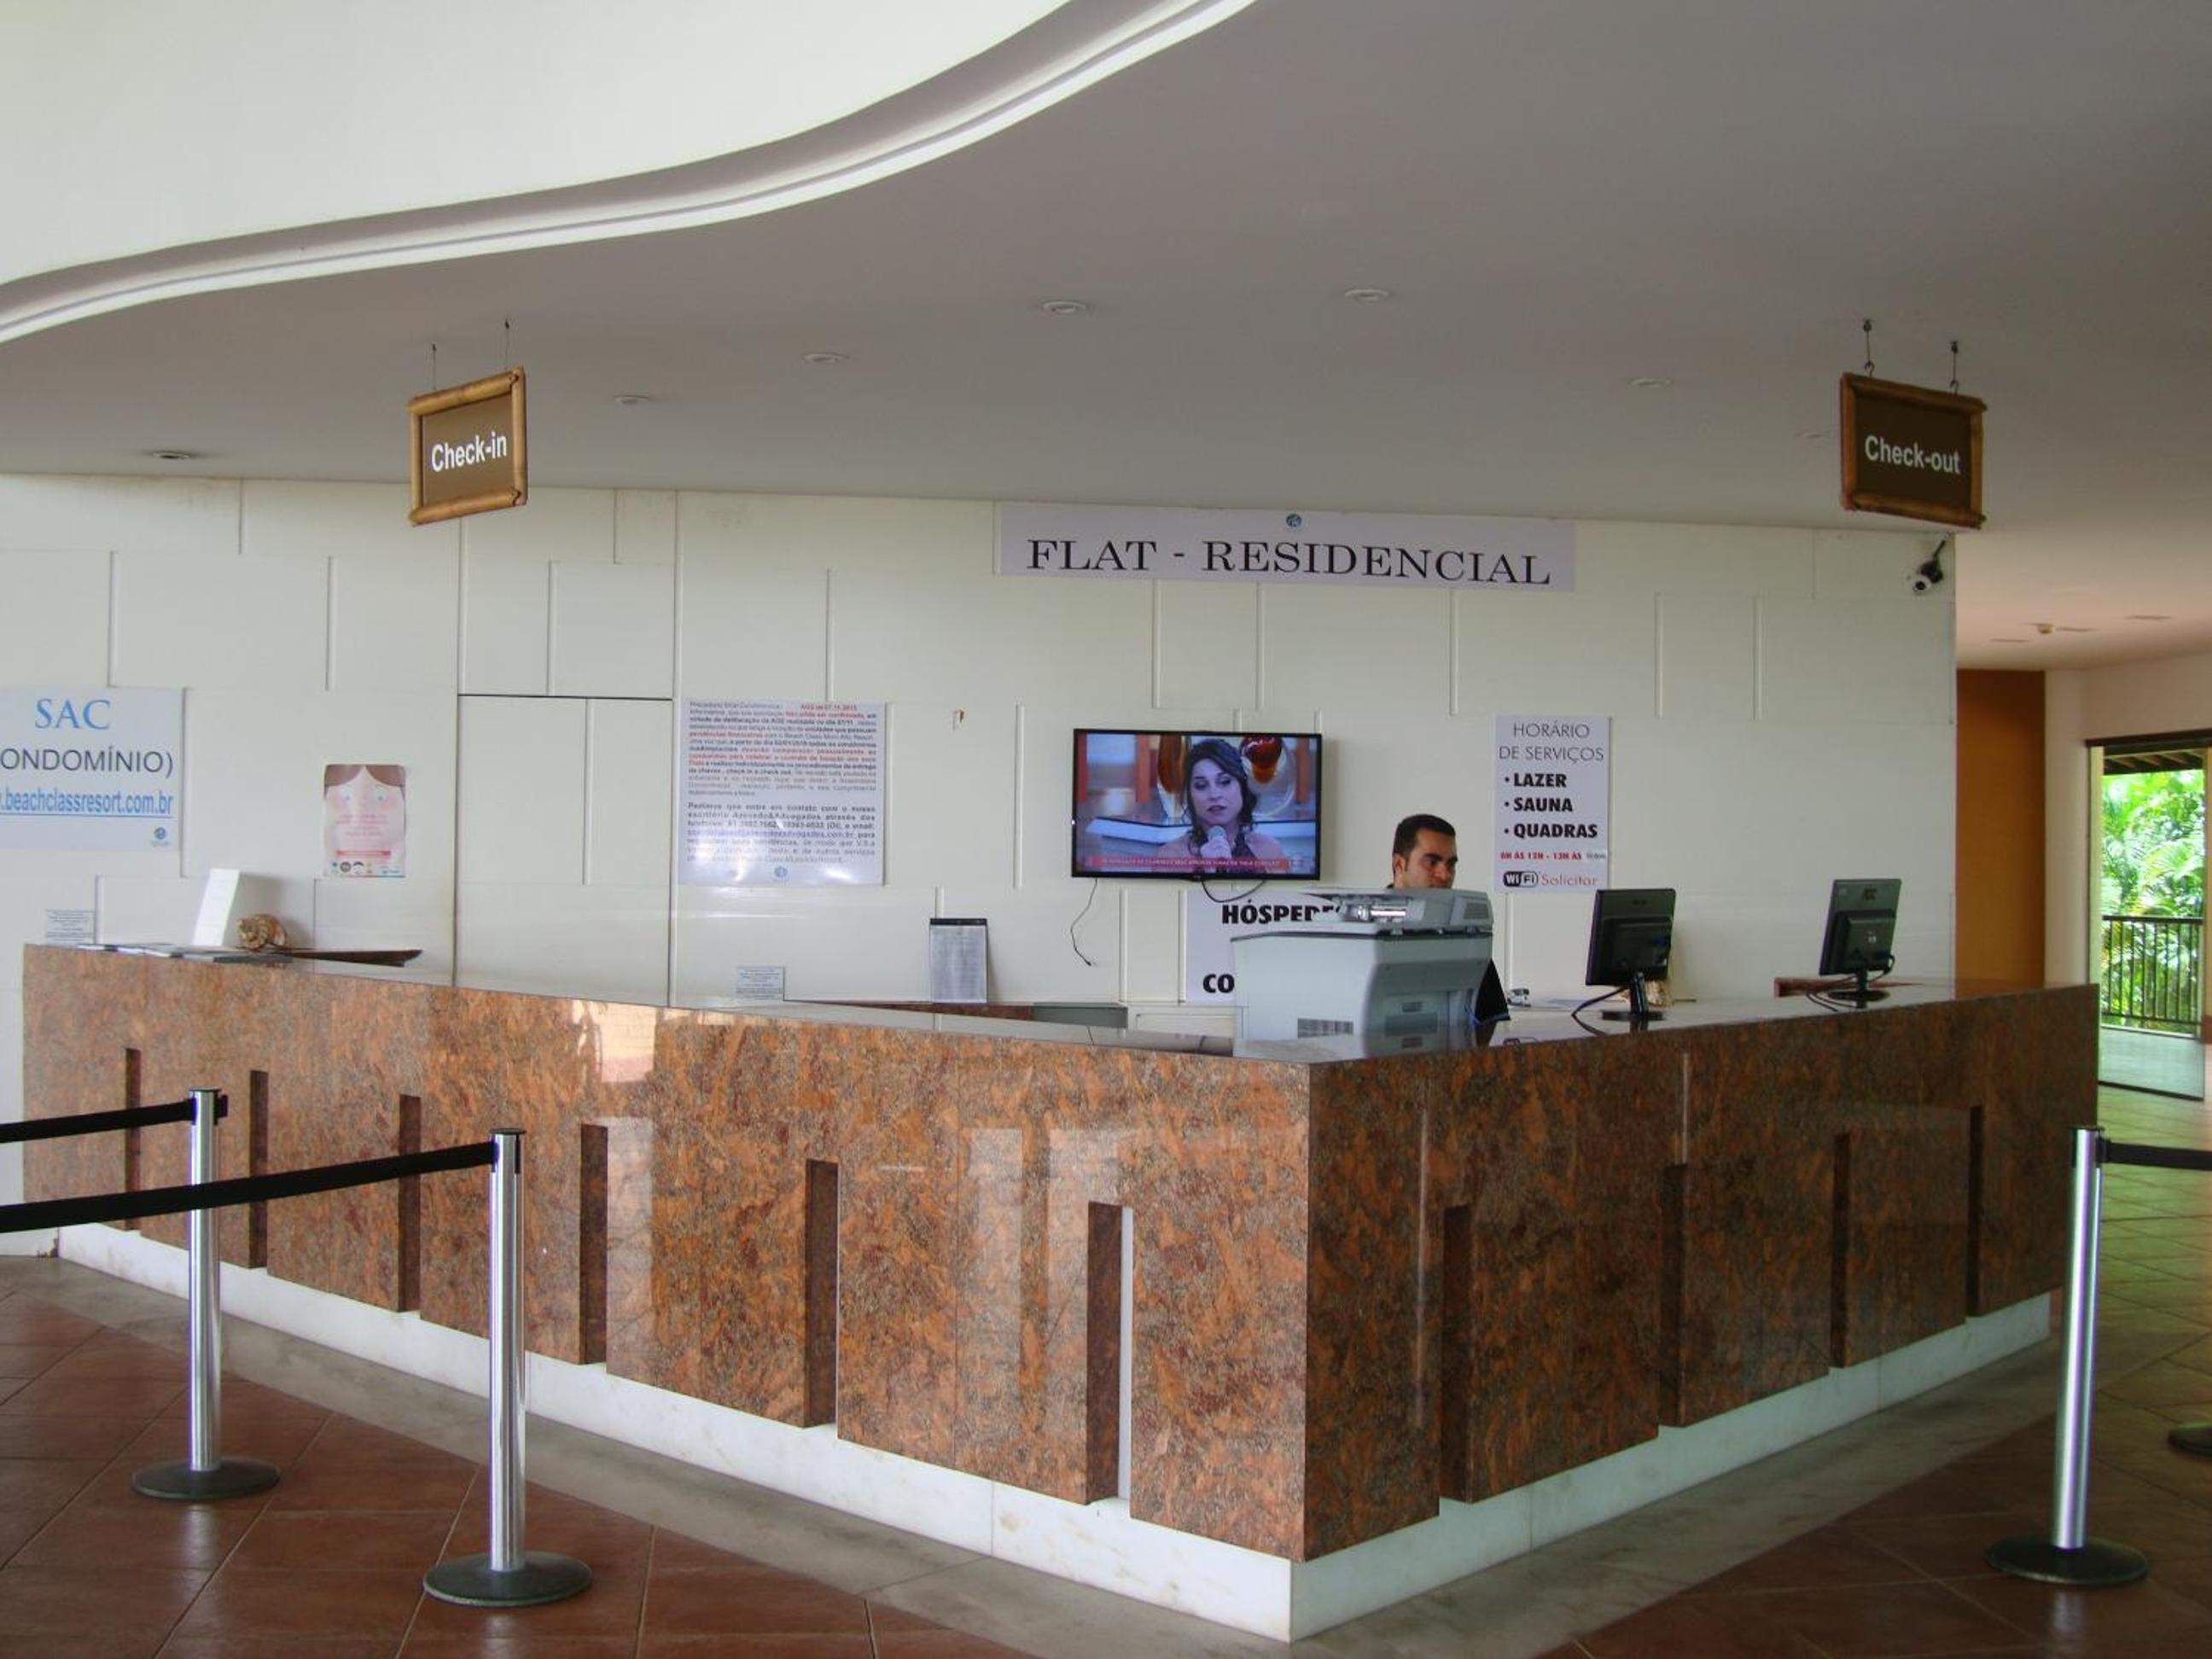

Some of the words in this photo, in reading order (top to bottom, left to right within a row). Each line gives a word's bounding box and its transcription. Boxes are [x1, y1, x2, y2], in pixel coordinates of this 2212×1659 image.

[431, 430, 507, 472] Check-in
[1865, 434, 1960, 474] Check-out
[1026, 538, 1156, 570] FLAT
[1202, 540, 1551, 585] RESIDENCIAL
[35, 698, 111, 730] SAC
[1513, 719, 1590, 738] HORÁRIO
[1499, 745, 1519, 760] DE
[1525, 746, 1604, 764] SERVIÇOS
[1513, 772, 1567, 788] LAZER
[0, 786, 173, 815] .beachclassresort.com.br
[1513, 797, 1573, 812] SAUNA
[1513, 823, 1598, 840] QUADRAS
[1541, 874, 1598, 886] Solicitar
